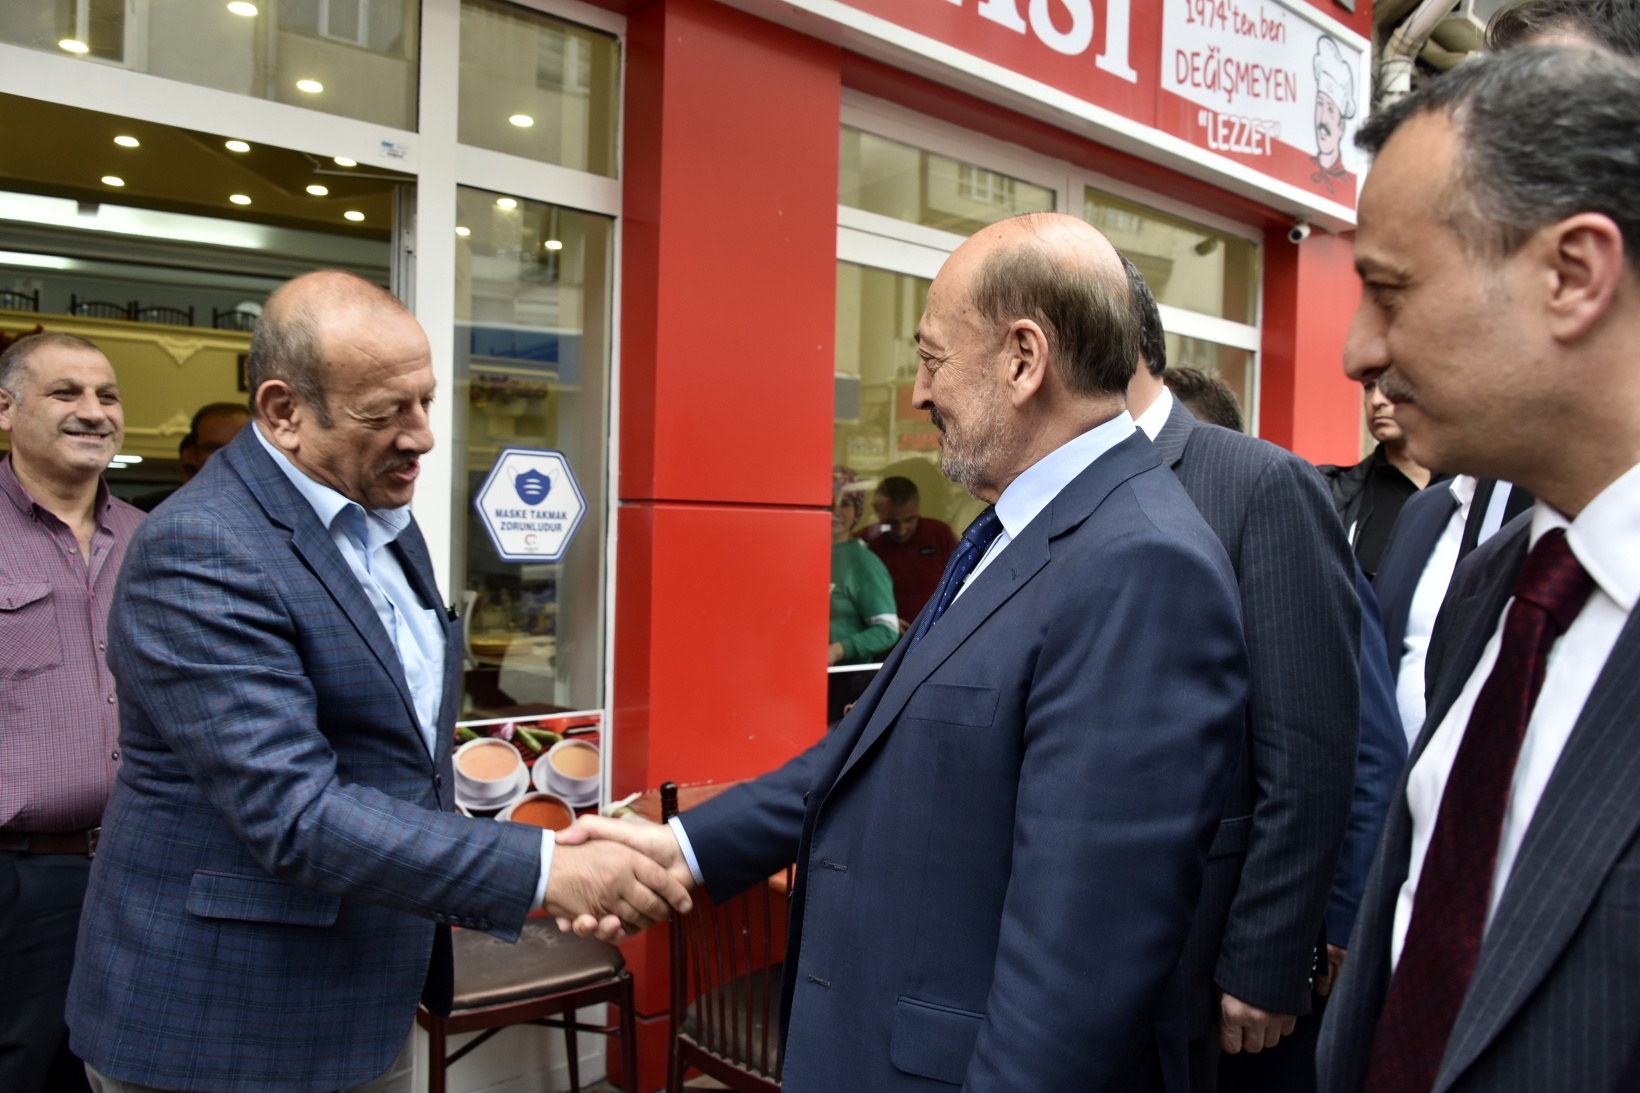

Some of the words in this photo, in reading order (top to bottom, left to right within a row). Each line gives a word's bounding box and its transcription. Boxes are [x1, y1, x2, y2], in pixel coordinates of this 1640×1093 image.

[944, 0, 1137, 84] SI
[1260, 5, 1287, 45] beri
[1176, 44, 1297, 104] DEĞİŞMEYEN
[495, 508, 527, 520] MASKE
[530, 510, 568, 520] TAKMAK
[500, 521, 563, 533] ZORUNLUDUR
